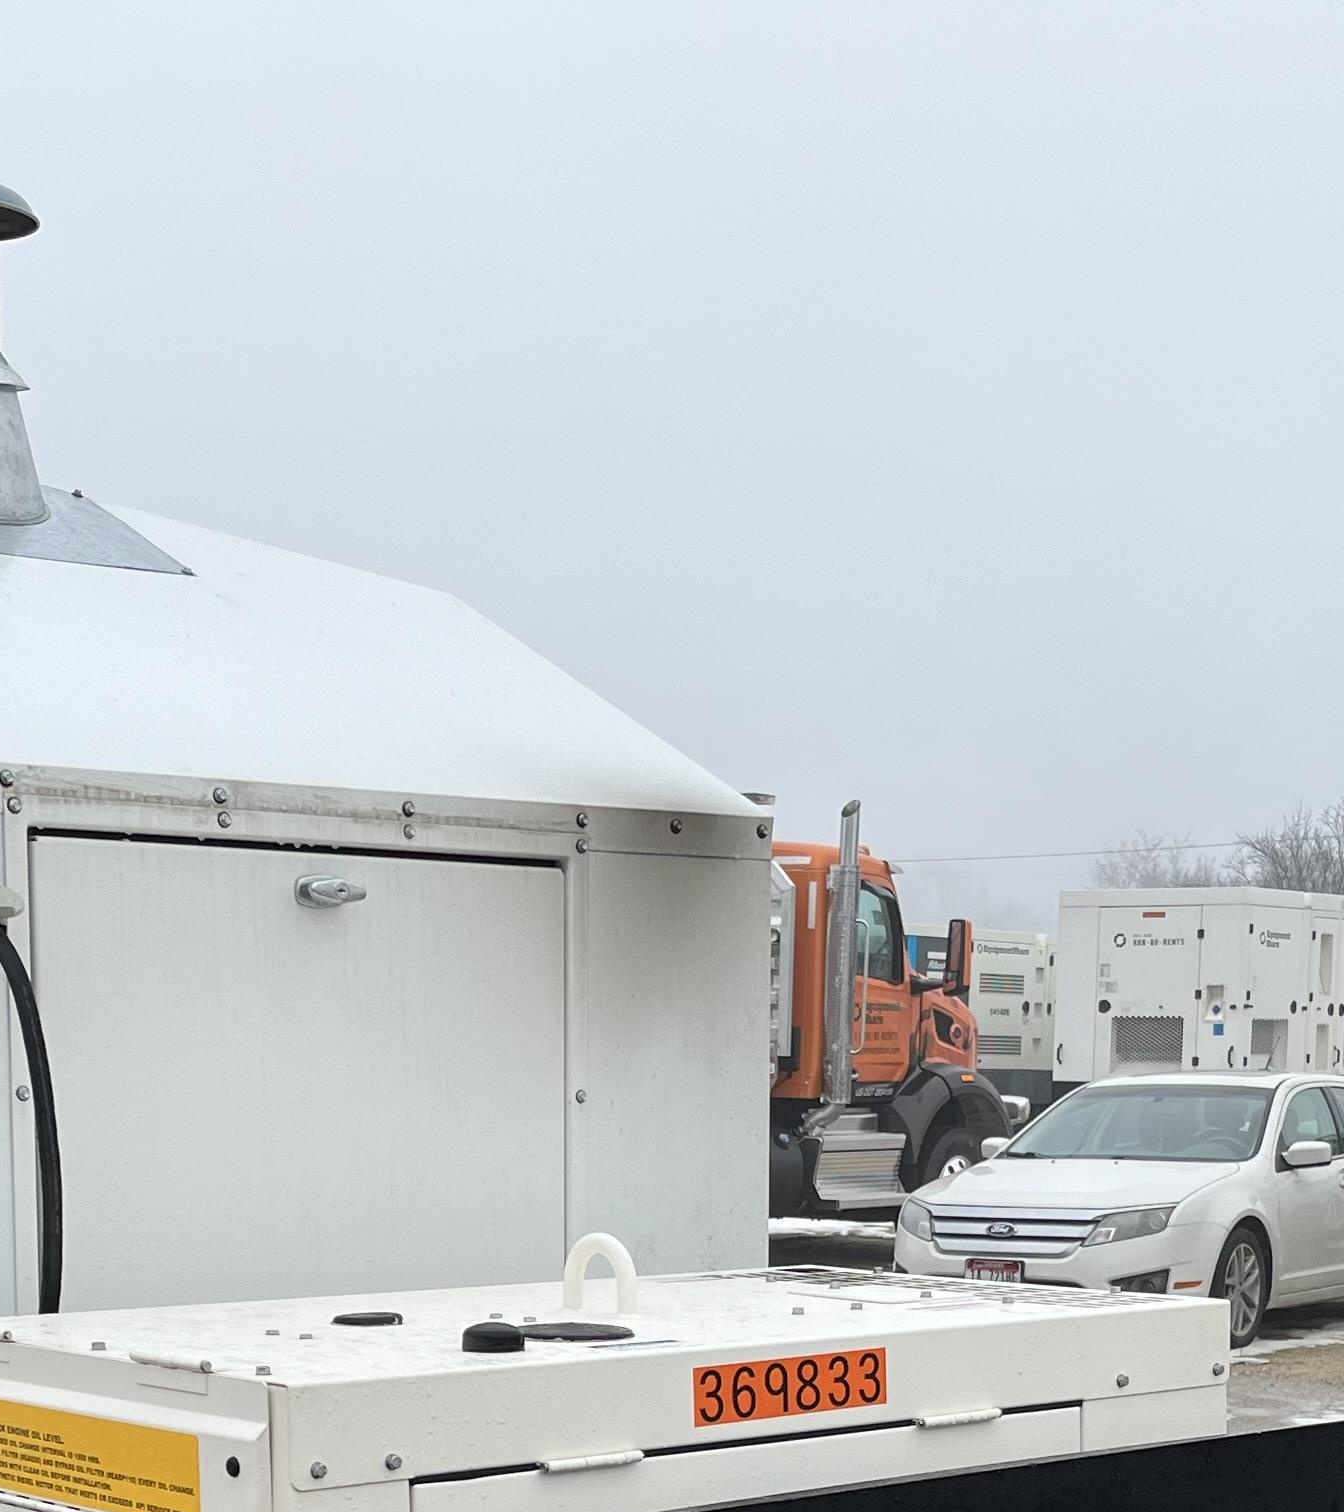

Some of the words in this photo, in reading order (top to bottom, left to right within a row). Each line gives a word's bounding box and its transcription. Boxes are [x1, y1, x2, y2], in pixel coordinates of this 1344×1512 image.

[699, 1352, 881, 1423] 369833
[7, 1426, 29, 1437] ENGINE
[31, 1430, 40, 1439] OIL
[43, 1433, 63, 1443] LEVEL.
[2, 1449, 17, 1458] FILTER
[43, 1458, 53, 1466] AND
[76, 1464, 84, 1472] OIL
[86, 1467, 104, 1476] FILTER
[138, 1477, 156, 1487] EVERY
[158, 1481, 167, 1489] OIL
